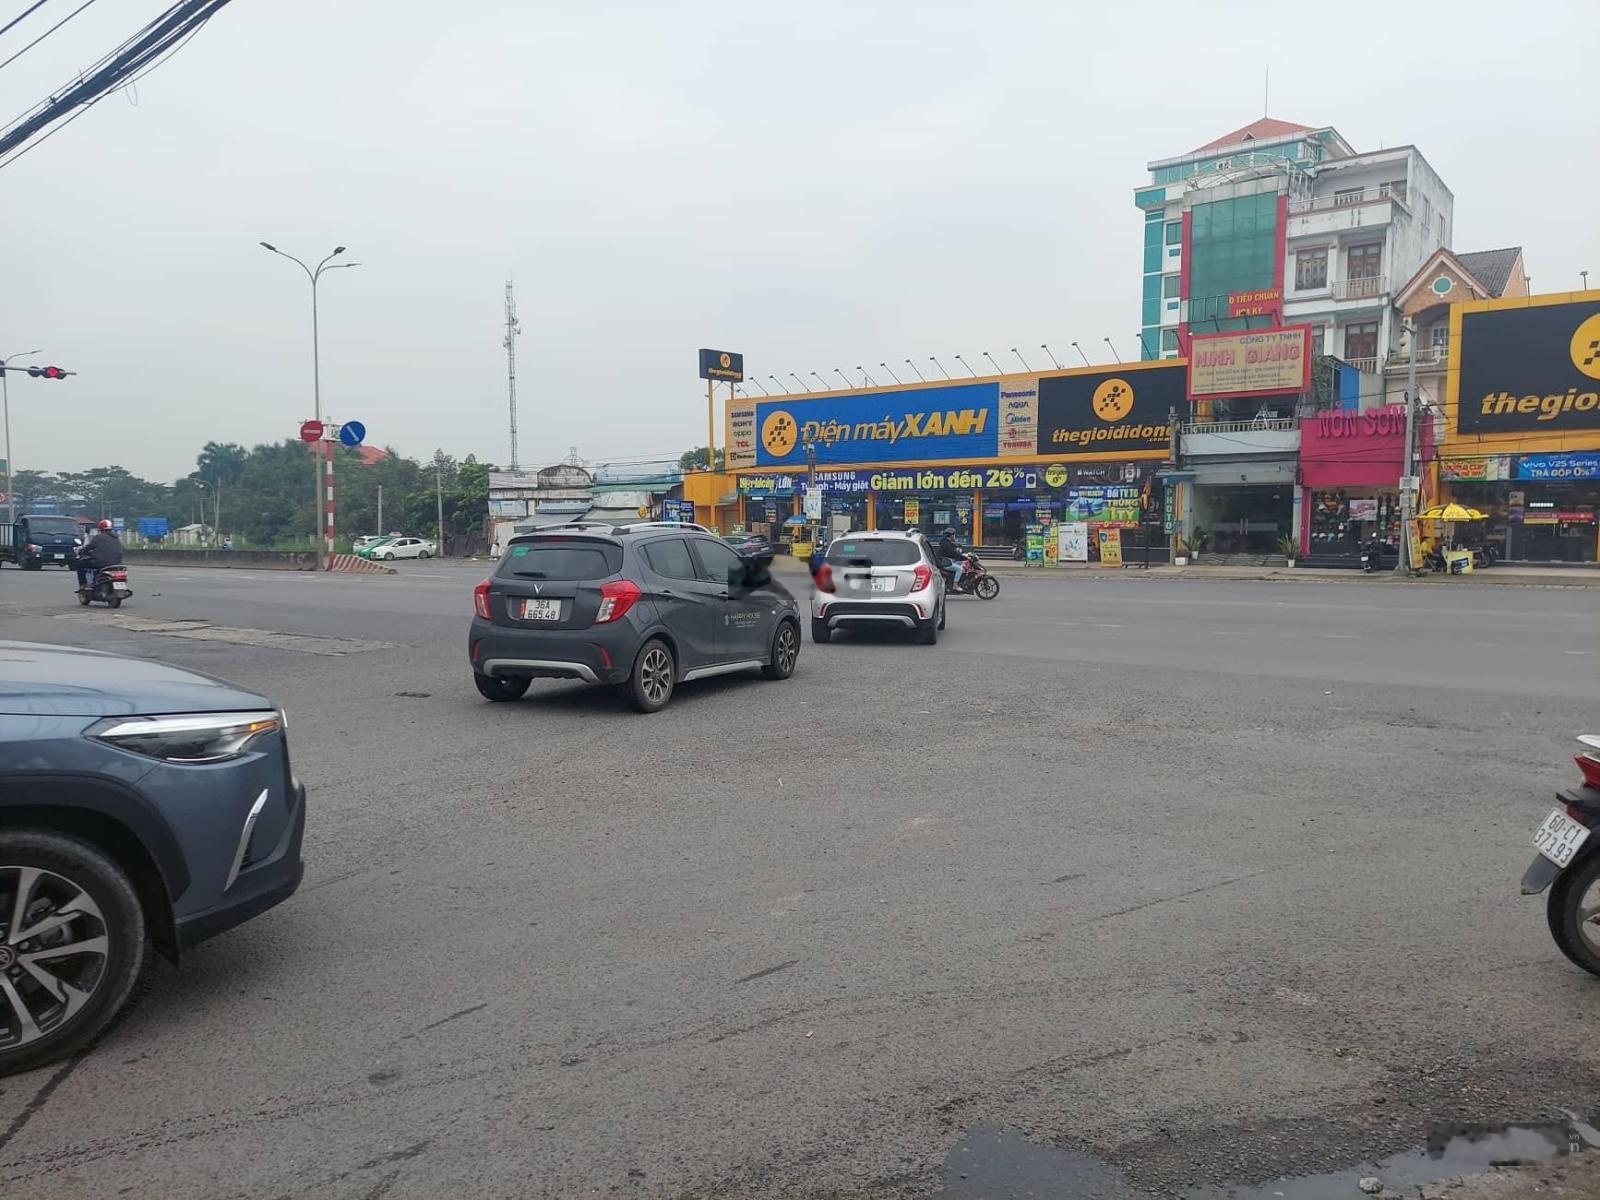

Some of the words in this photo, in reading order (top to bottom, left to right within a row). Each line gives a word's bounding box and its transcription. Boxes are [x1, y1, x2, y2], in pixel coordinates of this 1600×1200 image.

[1279, 332, 1302, 340] TNHH
[1195, 349, 1235, 368] NINH
[1247, 343, 1300, 365] GIANG
[1008, 401, 1029, 409] AQUA
[1481, 388, 1600, 421] thegio
[736, 440, 750, 448] TCL
[1569, 458, 1598, 467] Series
[871, 472, 913, 490] Giảm
[917, 470, 944, 489] lớn
[948, 469, 983, 488] đến
[987, 467, 1024, 487] 26%
[834, 480, 851, 492] Máy
[852, 480, 869, 492] giặt
[535, 600, 550, 609] 36A
[527, 609, 556, 620] 665.48
[1534, 828, 1573, 863] 373.93
